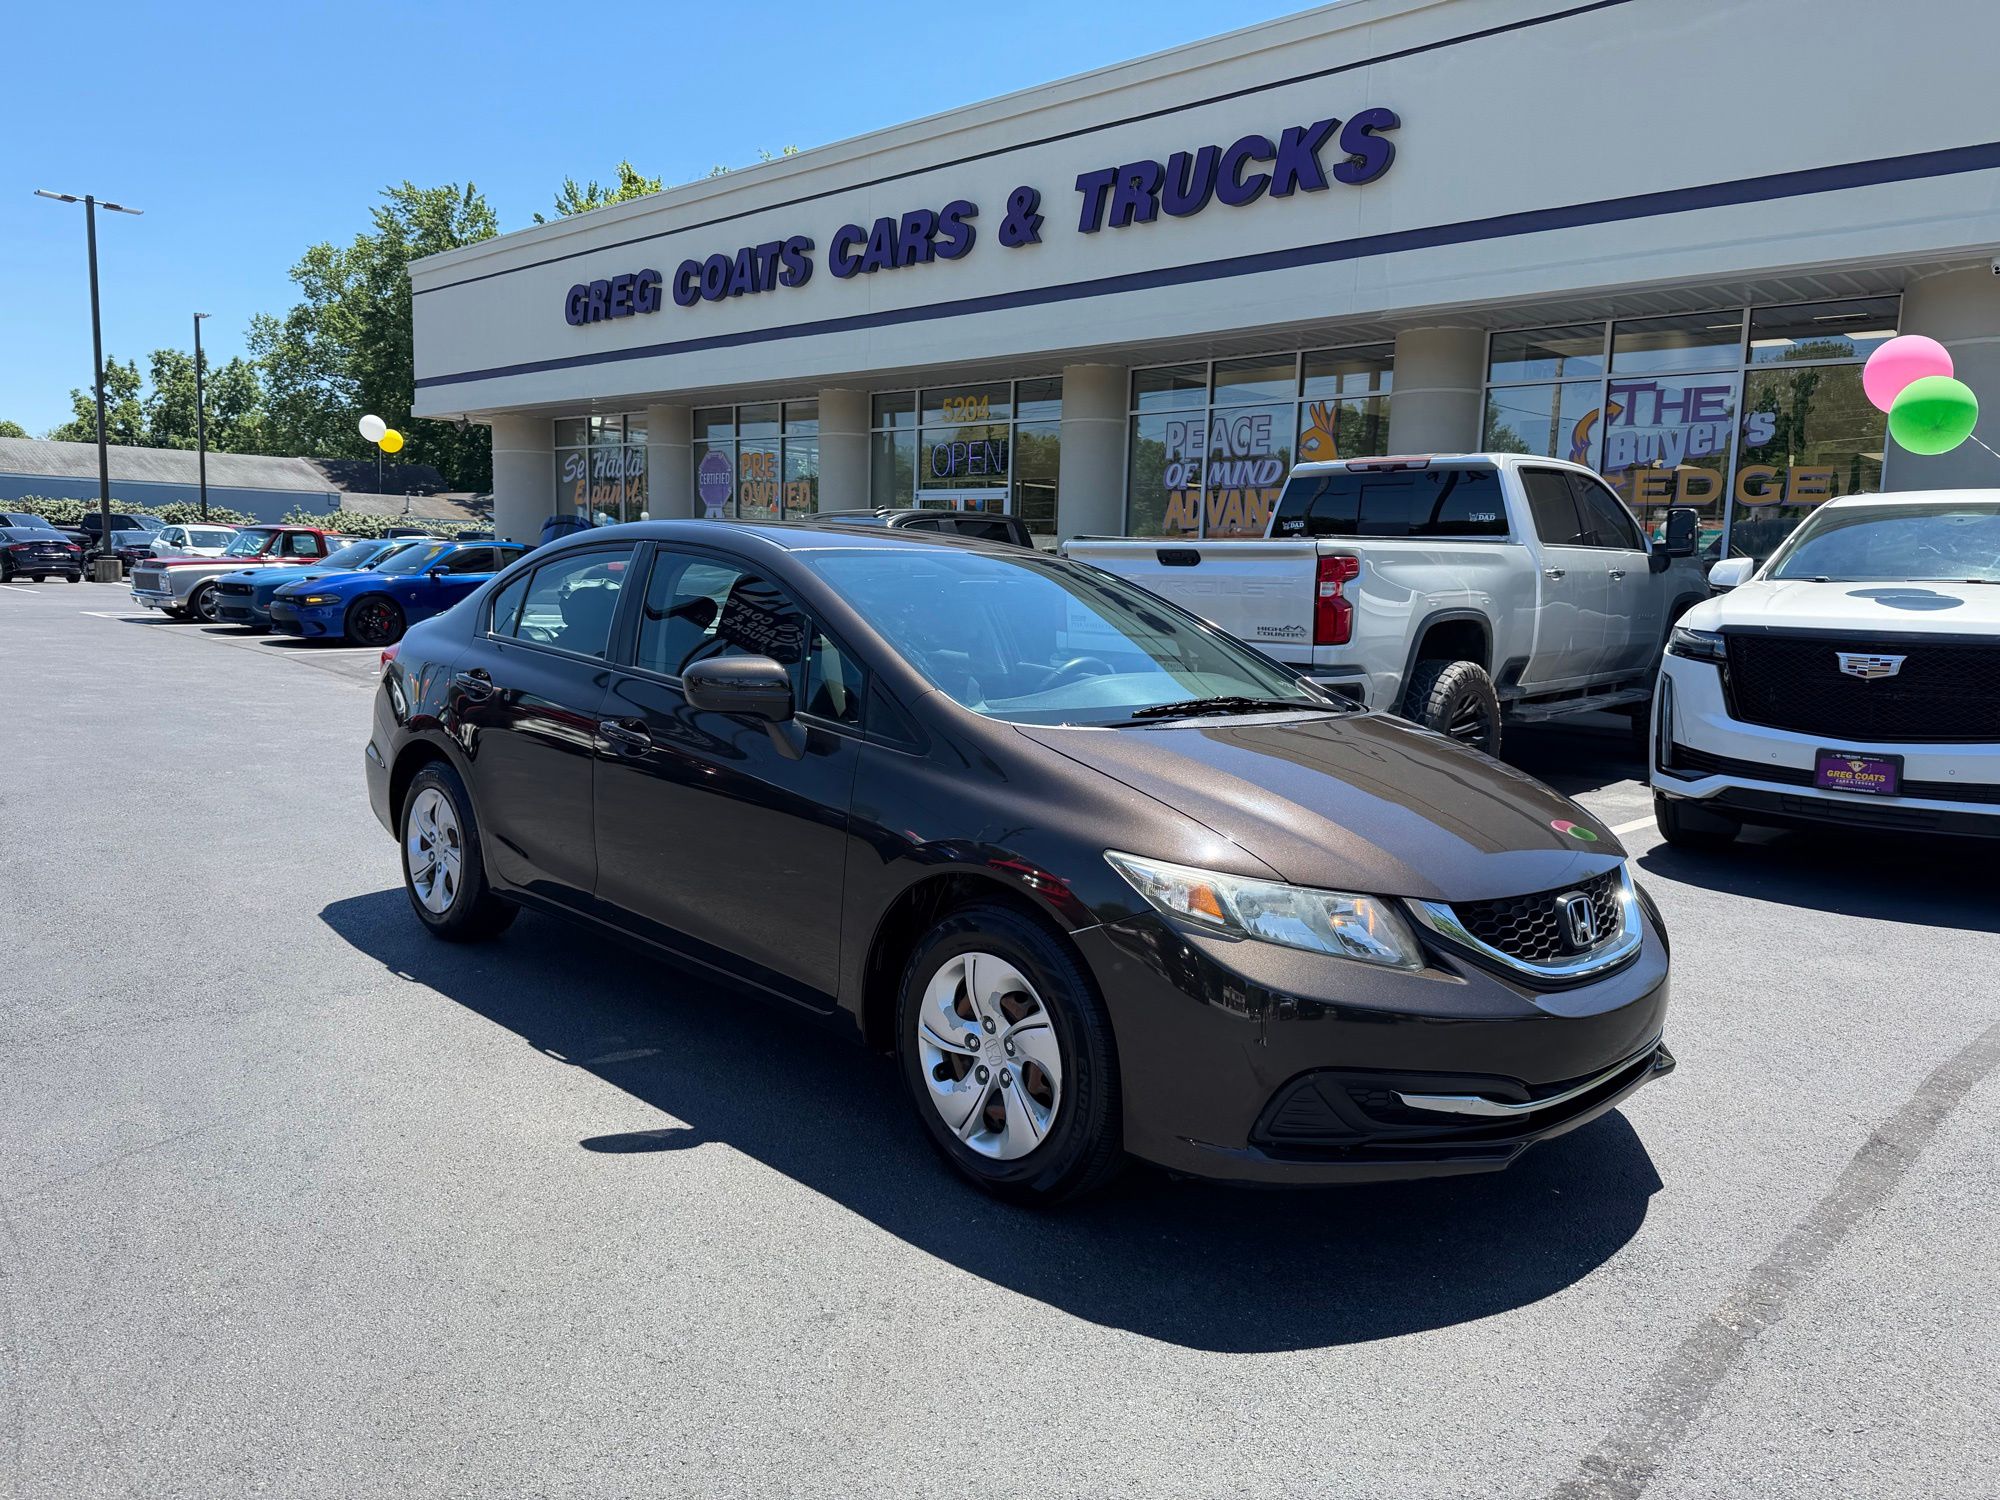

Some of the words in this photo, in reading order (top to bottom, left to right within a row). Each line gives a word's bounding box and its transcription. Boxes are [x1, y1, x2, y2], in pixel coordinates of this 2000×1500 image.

[565, 269, 662, 326] GREG
[673, 235, 815, 307] COATS
[829, 200, 979, 279] CARS
[999, 186, 1045, 248] &
[1075, 107, 1401, 234] TRUCKS
[943, 395, 990, 422] 5204
[1609, 382, 1731, 426] THE
[1165, 415, 1272, 459] PEACE
[563, 453, 585, 483] Se
[932, 440, 1002, 477] OPEN
[1163, 462, 1199, 490] OF
[1207, 459, 1284, 489] MIND
[699, 472, 731, 485] CERTIFIED
[1631, 464, 1834, 507] EDGE
[1826, 769, 1853, 779] GREG
[1854, 772, 1887, 782] COATS
